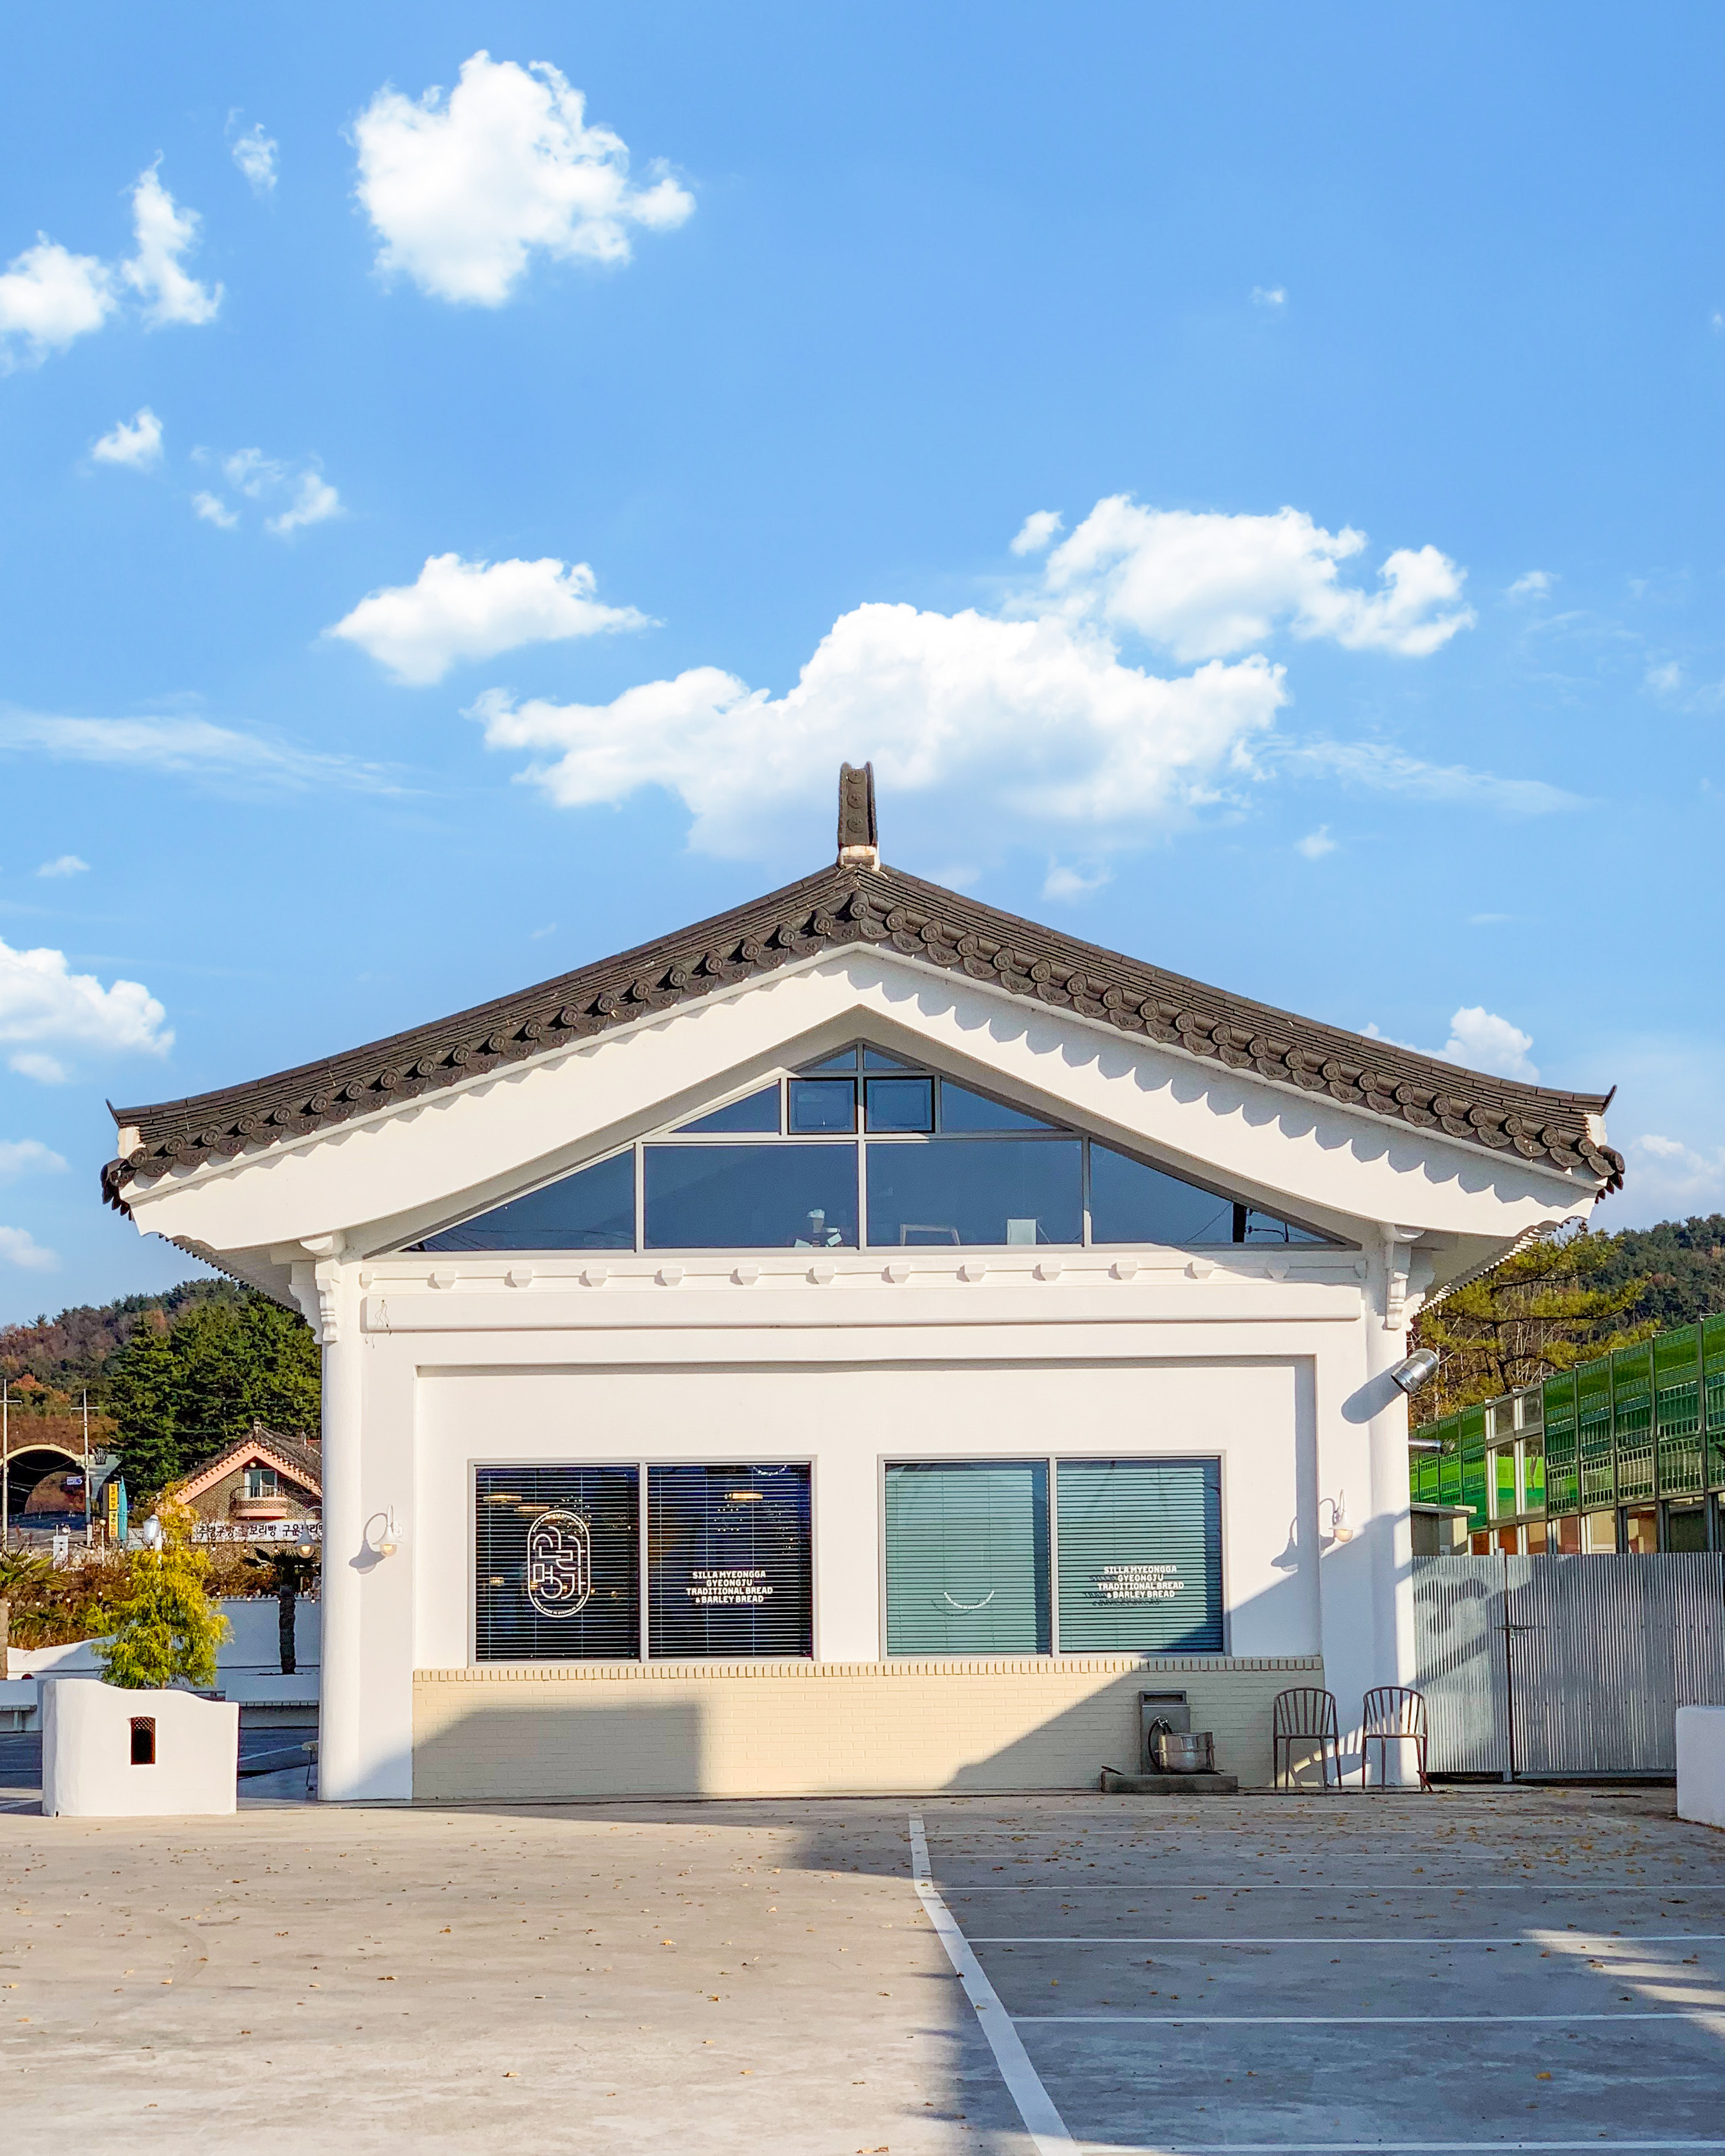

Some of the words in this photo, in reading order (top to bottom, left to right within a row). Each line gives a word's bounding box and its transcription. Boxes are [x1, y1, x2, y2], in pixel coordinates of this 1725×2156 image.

[1103, 1566, 1129, 1574] SILLA
[1130, 1565, 1177, 1573] MYEONGGA
[692, 1571, 718, 1579] SILLA
[719, 1570, 766, 1579] MYEONGGA
[706, 1579, 753, 1587] GYEONGJU
[1098, 1582, 1156, 1590] TRADITIONAL
[1156, 1582, 1184, 1590] BREAD
[686, 1587, 745, 1596] TRADITIONAL
[745, 1586, 774, 1595] BREAD
[1113, 1590, 1146, 1599] BARLEY
[1147, 1590, 1175, 1598] BREAD
[701, 1595, 735, 1603] BARLEY
[736, 1595, 764, 1603] BREAD
